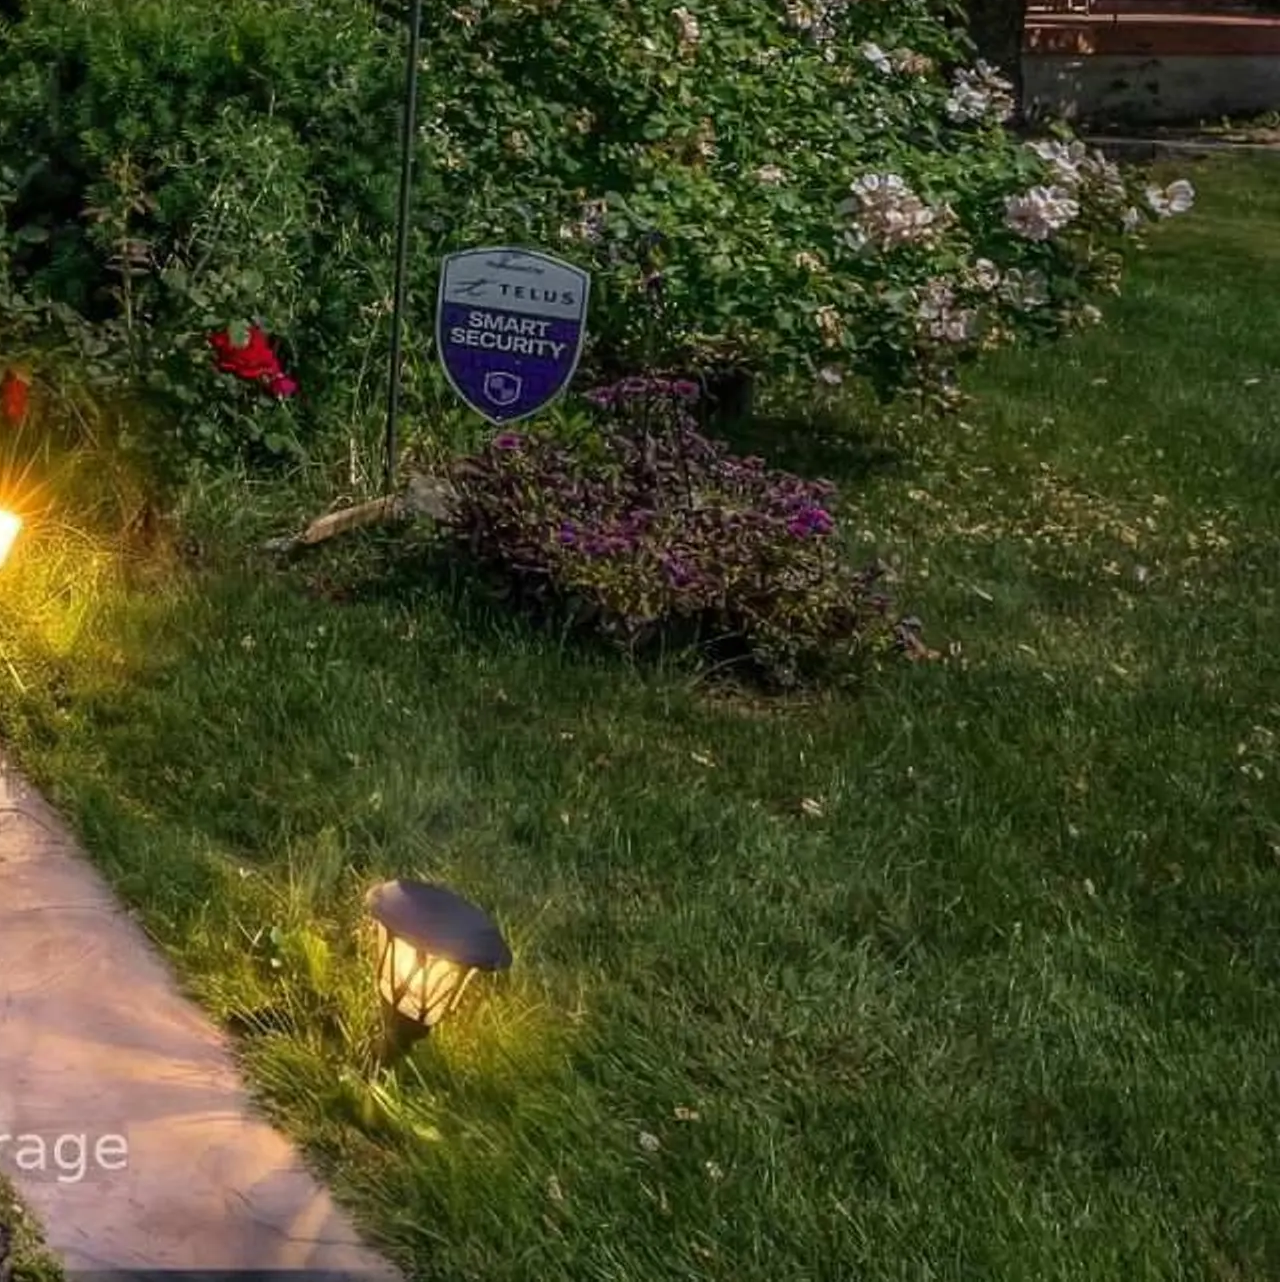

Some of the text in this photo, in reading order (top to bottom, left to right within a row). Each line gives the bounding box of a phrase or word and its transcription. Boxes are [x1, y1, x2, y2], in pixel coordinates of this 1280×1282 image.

[498, 283, 576, 306] TELUS
[468, 310, 553, 338] SMART
[450, 326, 567, 360] SECURITY
